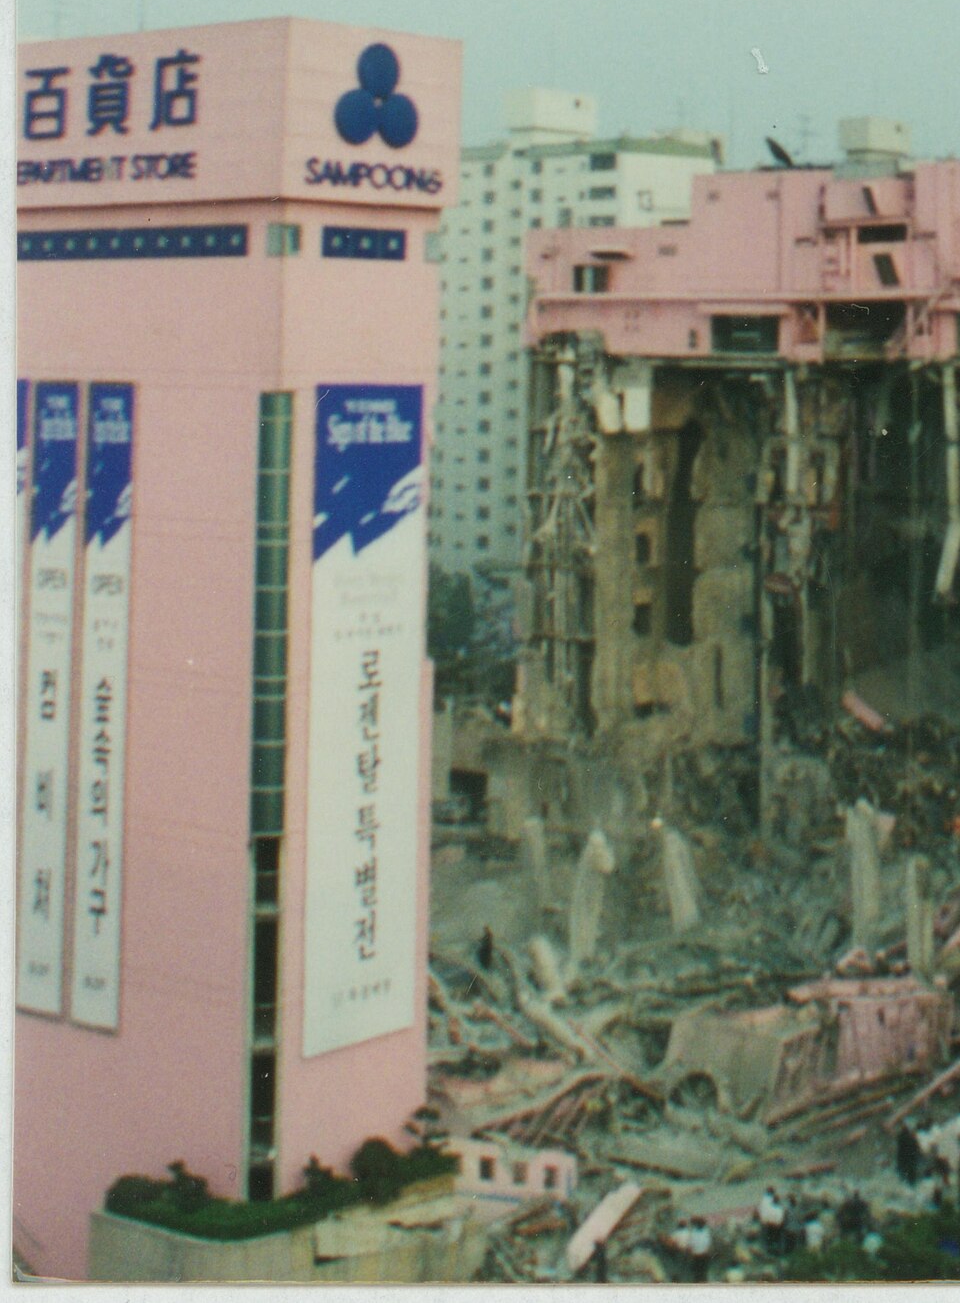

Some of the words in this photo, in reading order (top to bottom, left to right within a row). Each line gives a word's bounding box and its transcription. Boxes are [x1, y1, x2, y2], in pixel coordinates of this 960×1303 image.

[22, 49, 203, 140] 百貨店
[131, 152, 198, 182] STORE
[304, 156, 443, 195] SAMPOONG
